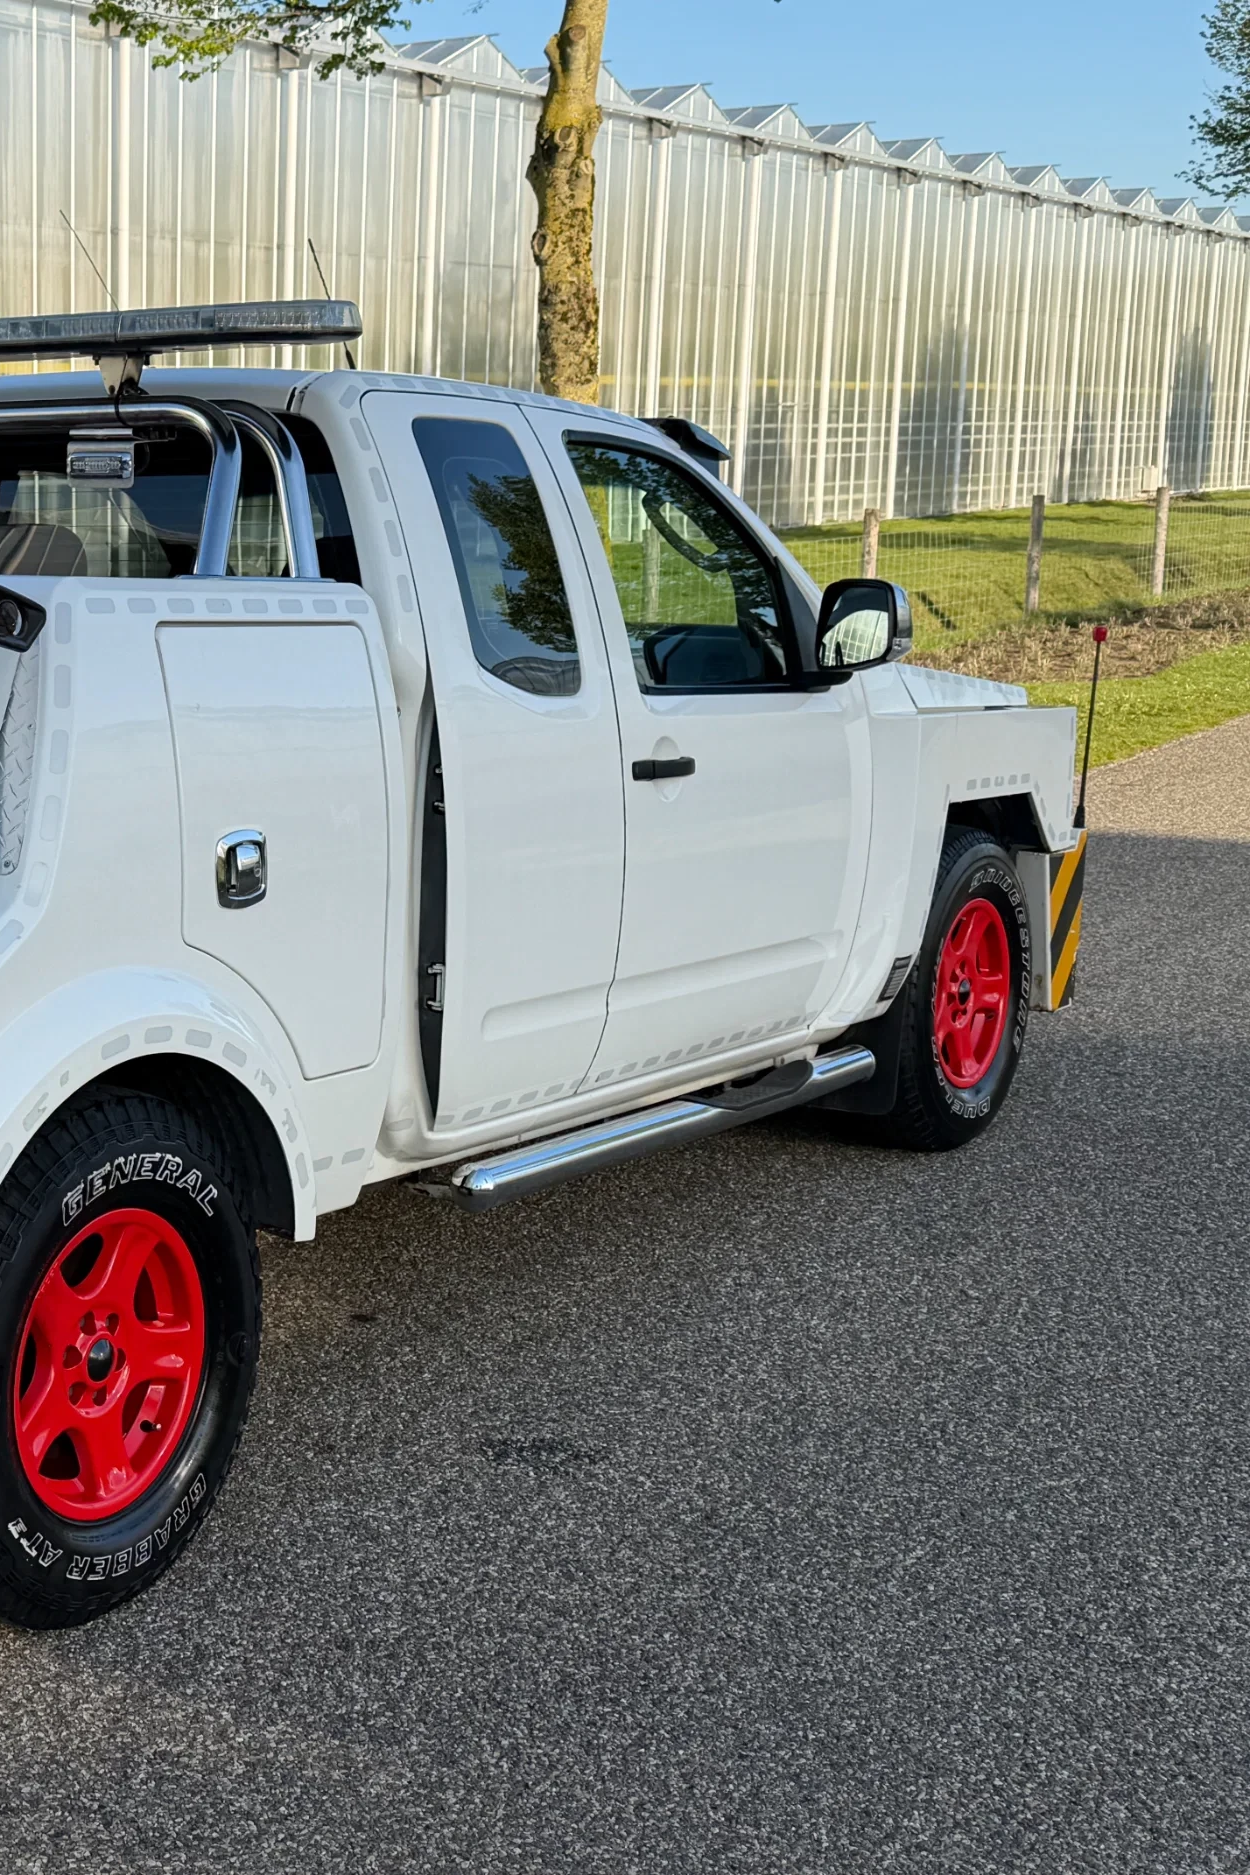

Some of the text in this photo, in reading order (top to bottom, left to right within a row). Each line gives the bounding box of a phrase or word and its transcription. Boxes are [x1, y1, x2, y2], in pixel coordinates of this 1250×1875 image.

[968, 868, 1031, 1054] BRIDGESTONE
[61, 1152, 218, 1227] GENERAL
[66, 1472, 207, 1581] GRABBER
